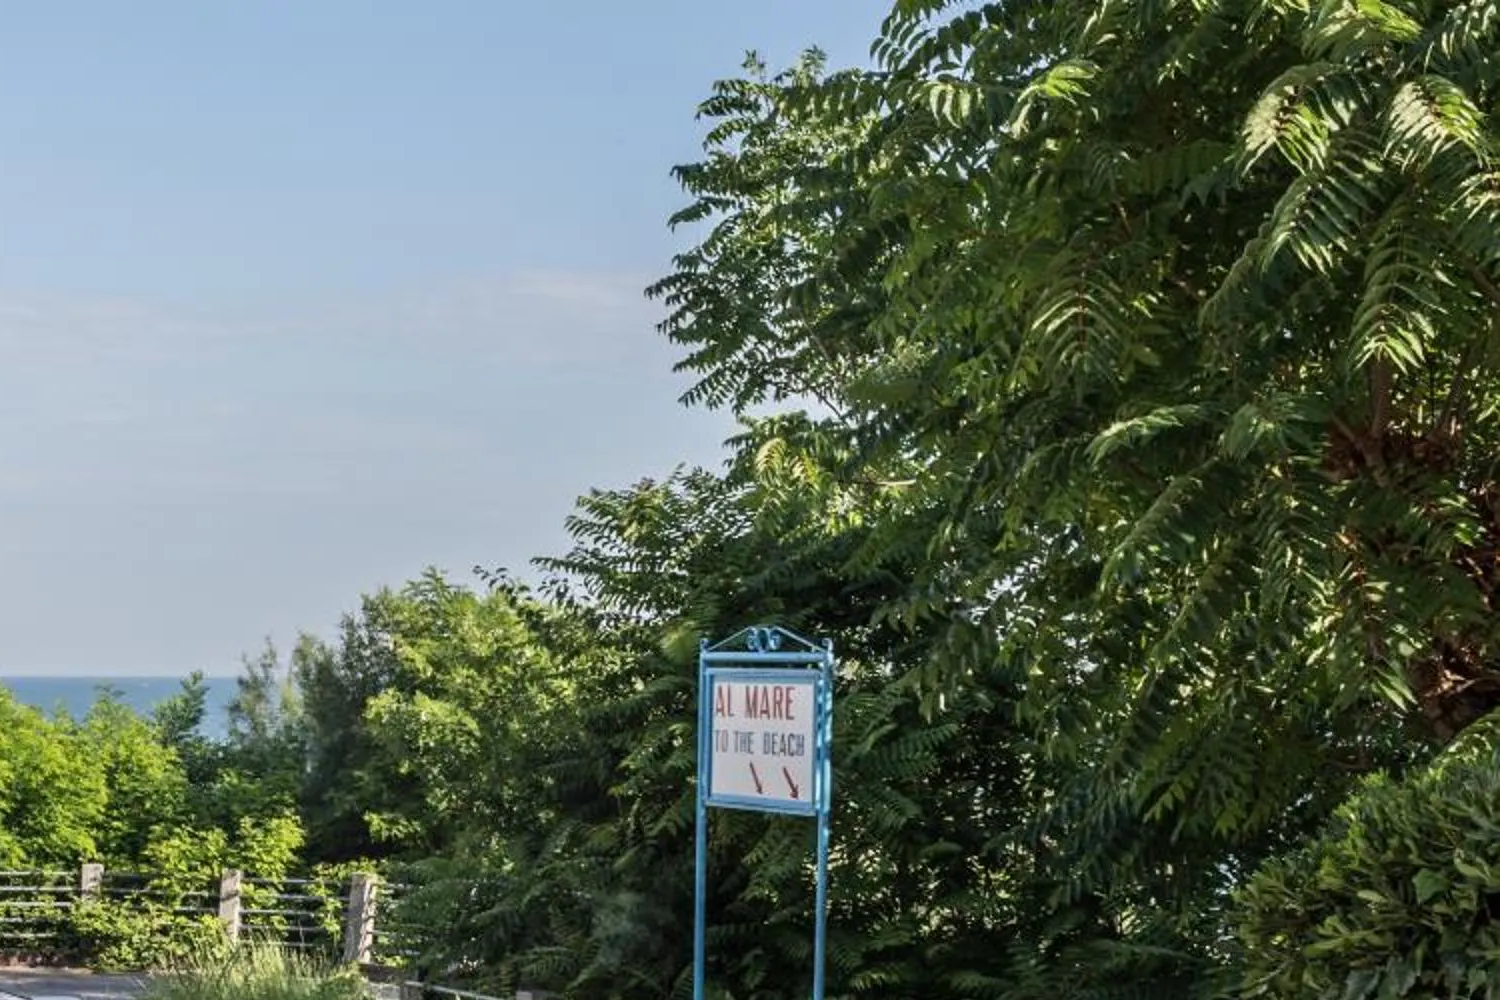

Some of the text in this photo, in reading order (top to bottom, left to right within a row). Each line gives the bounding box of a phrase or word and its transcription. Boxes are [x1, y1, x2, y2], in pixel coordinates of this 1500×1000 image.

[715, 684, 795, 720] AL MARE
[715, 730, 805, 757] TO THE BEACH
